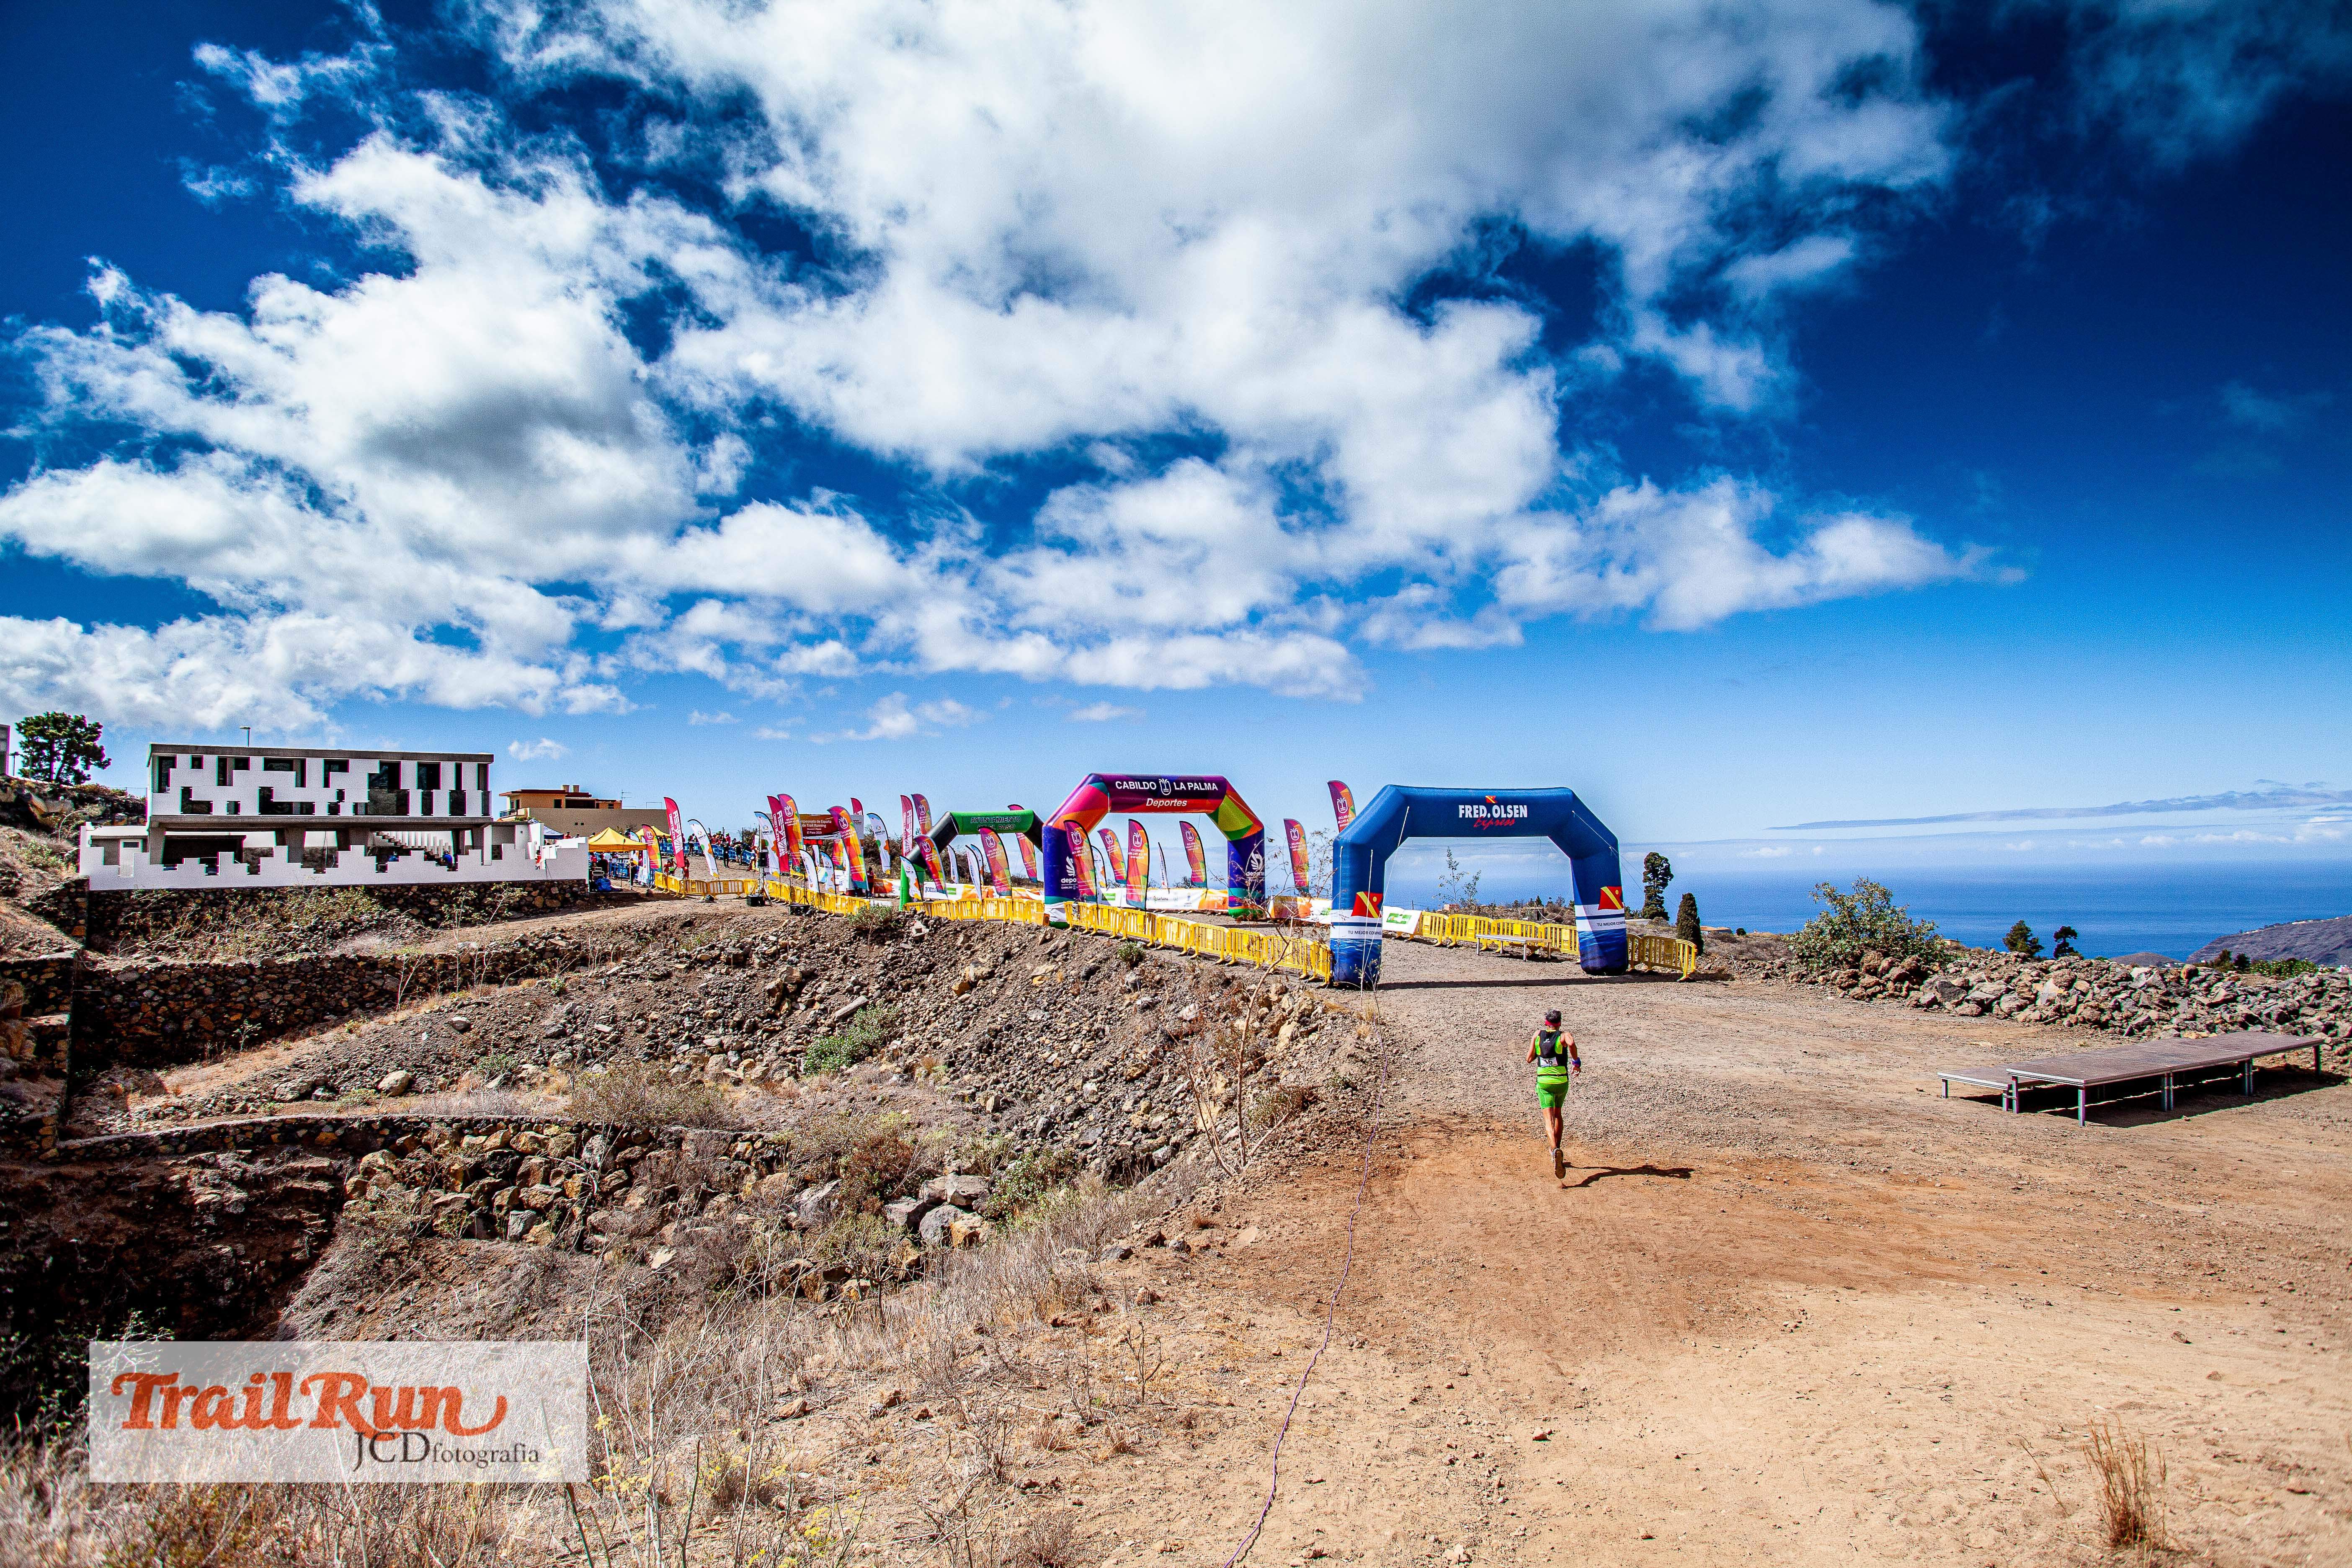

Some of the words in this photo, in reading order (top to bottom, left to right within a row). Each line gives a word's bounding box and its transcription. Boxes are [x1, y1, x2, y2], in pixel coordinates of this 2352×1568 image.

[1115, 781, 1156, 790] CABILDO
[1187, 782, 1218, 791] PALMA
[1146, 798, 1187, 807] Deportes
[1459, 805, 1491, 818] FRED.
[1492, 805, 1527, 818] OLSEN
